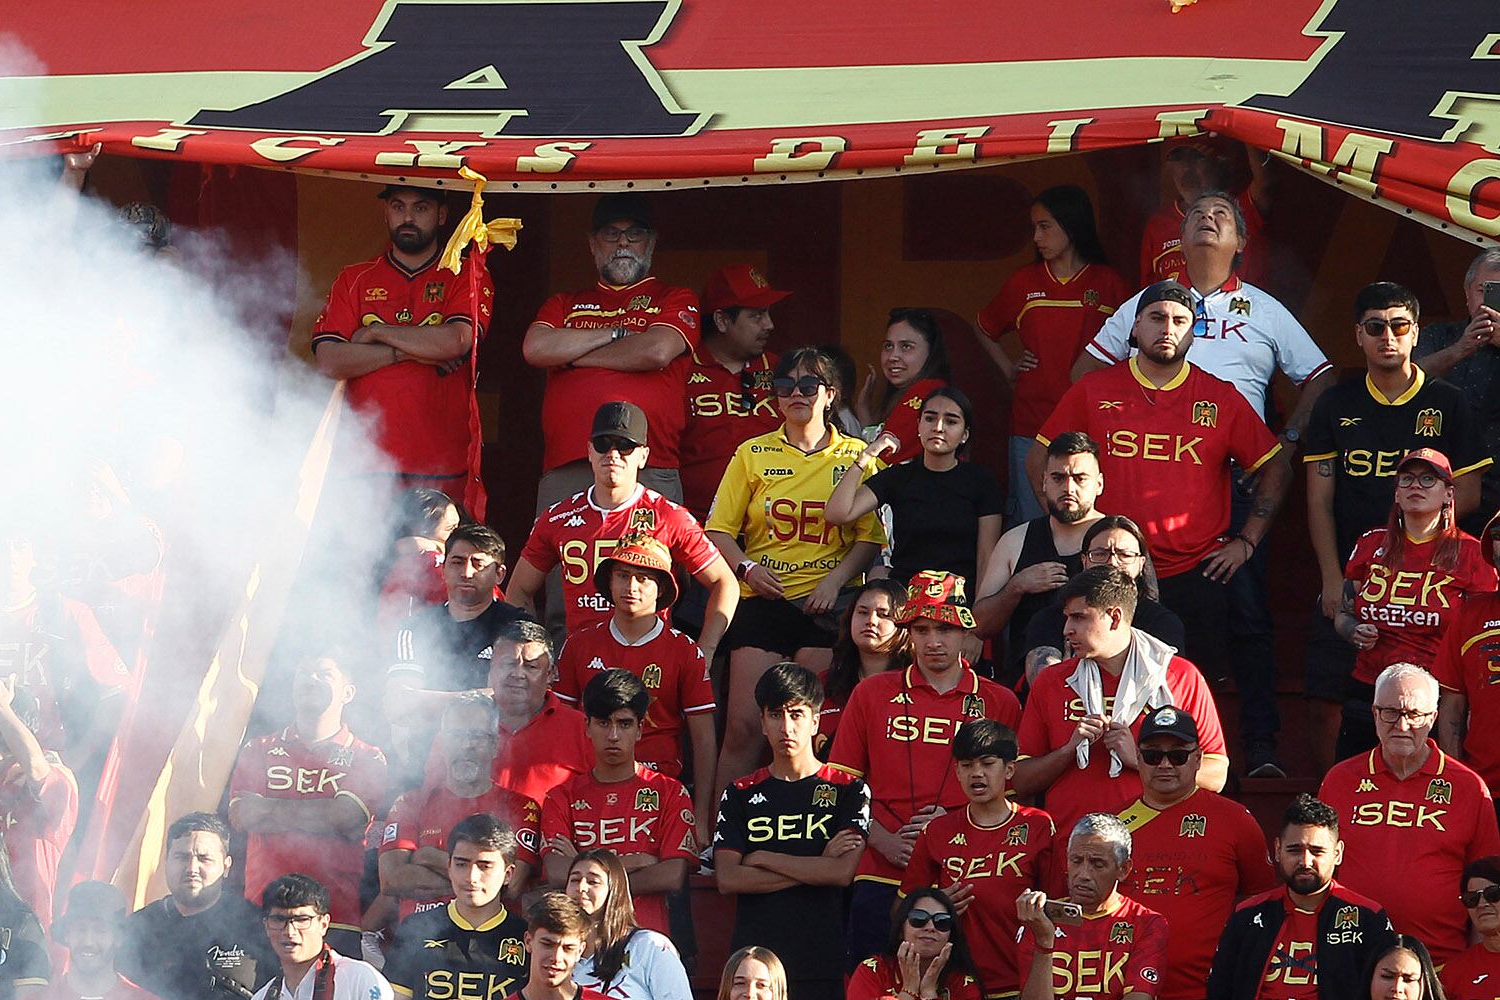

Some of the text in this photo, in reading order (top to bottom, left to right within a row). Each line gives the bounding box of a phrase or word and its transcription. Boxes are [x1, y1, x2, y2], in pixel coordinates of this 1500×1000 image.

[1111, 430, 1203, 466] SEK
[1348, 449, 1400, 477] SE
[760, 554, 799, 573] Bruno
[1365, 564, 1455, 608] SEK
[1361, 604, 1440, 627] starken
[891, 715, 964, 745] SE
[267, 767, 346, 794] SEK
[574, 815, 656, 847] SEK
[747, 813, 833, 842] SEK
[1356, 801, 1447, 831] SEK
[946, 850, 1025, 880] SEK
[1329, 930, 1363, 944] SEK
[1052, 951, 1130, 995] SEK
